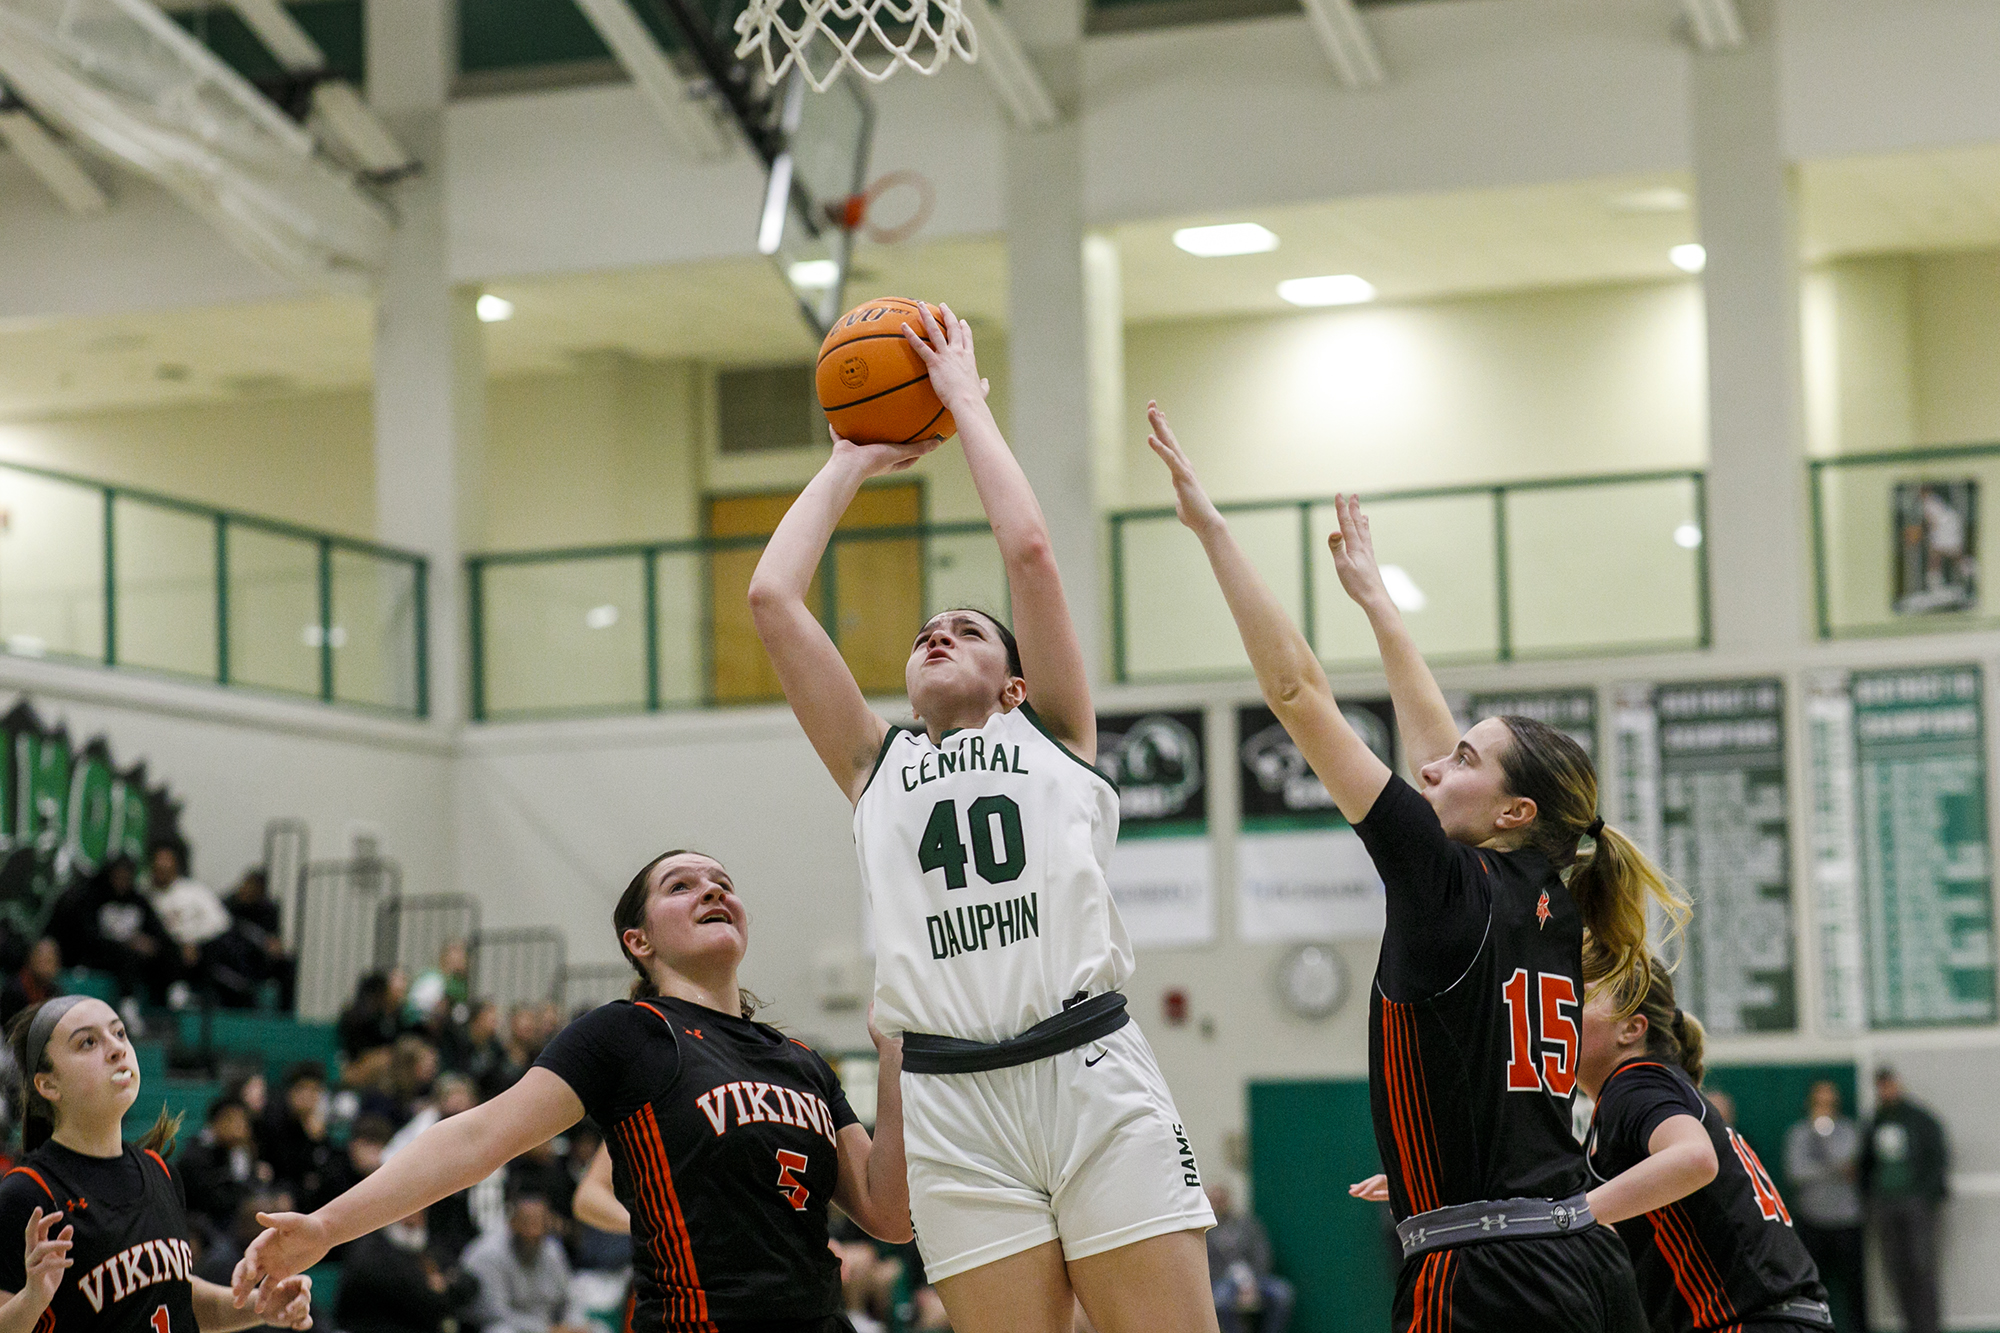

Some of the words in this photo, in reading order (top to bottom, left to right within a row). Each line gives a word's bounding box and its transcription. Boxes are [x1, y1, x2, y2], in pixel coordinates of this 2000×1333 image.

[901, 736, 1029, 792] CENTRAL
[917, 794, 1027, 891] 40
[926, 891, 1040, 960] DAUPHIN
[1502, 967, 1579, 1099] 15
[695, 1080, 837, 1150] VIKING
[775, 1148, 810, 1212] 5
[1172, 1123, 1201, 1187] RAMS
